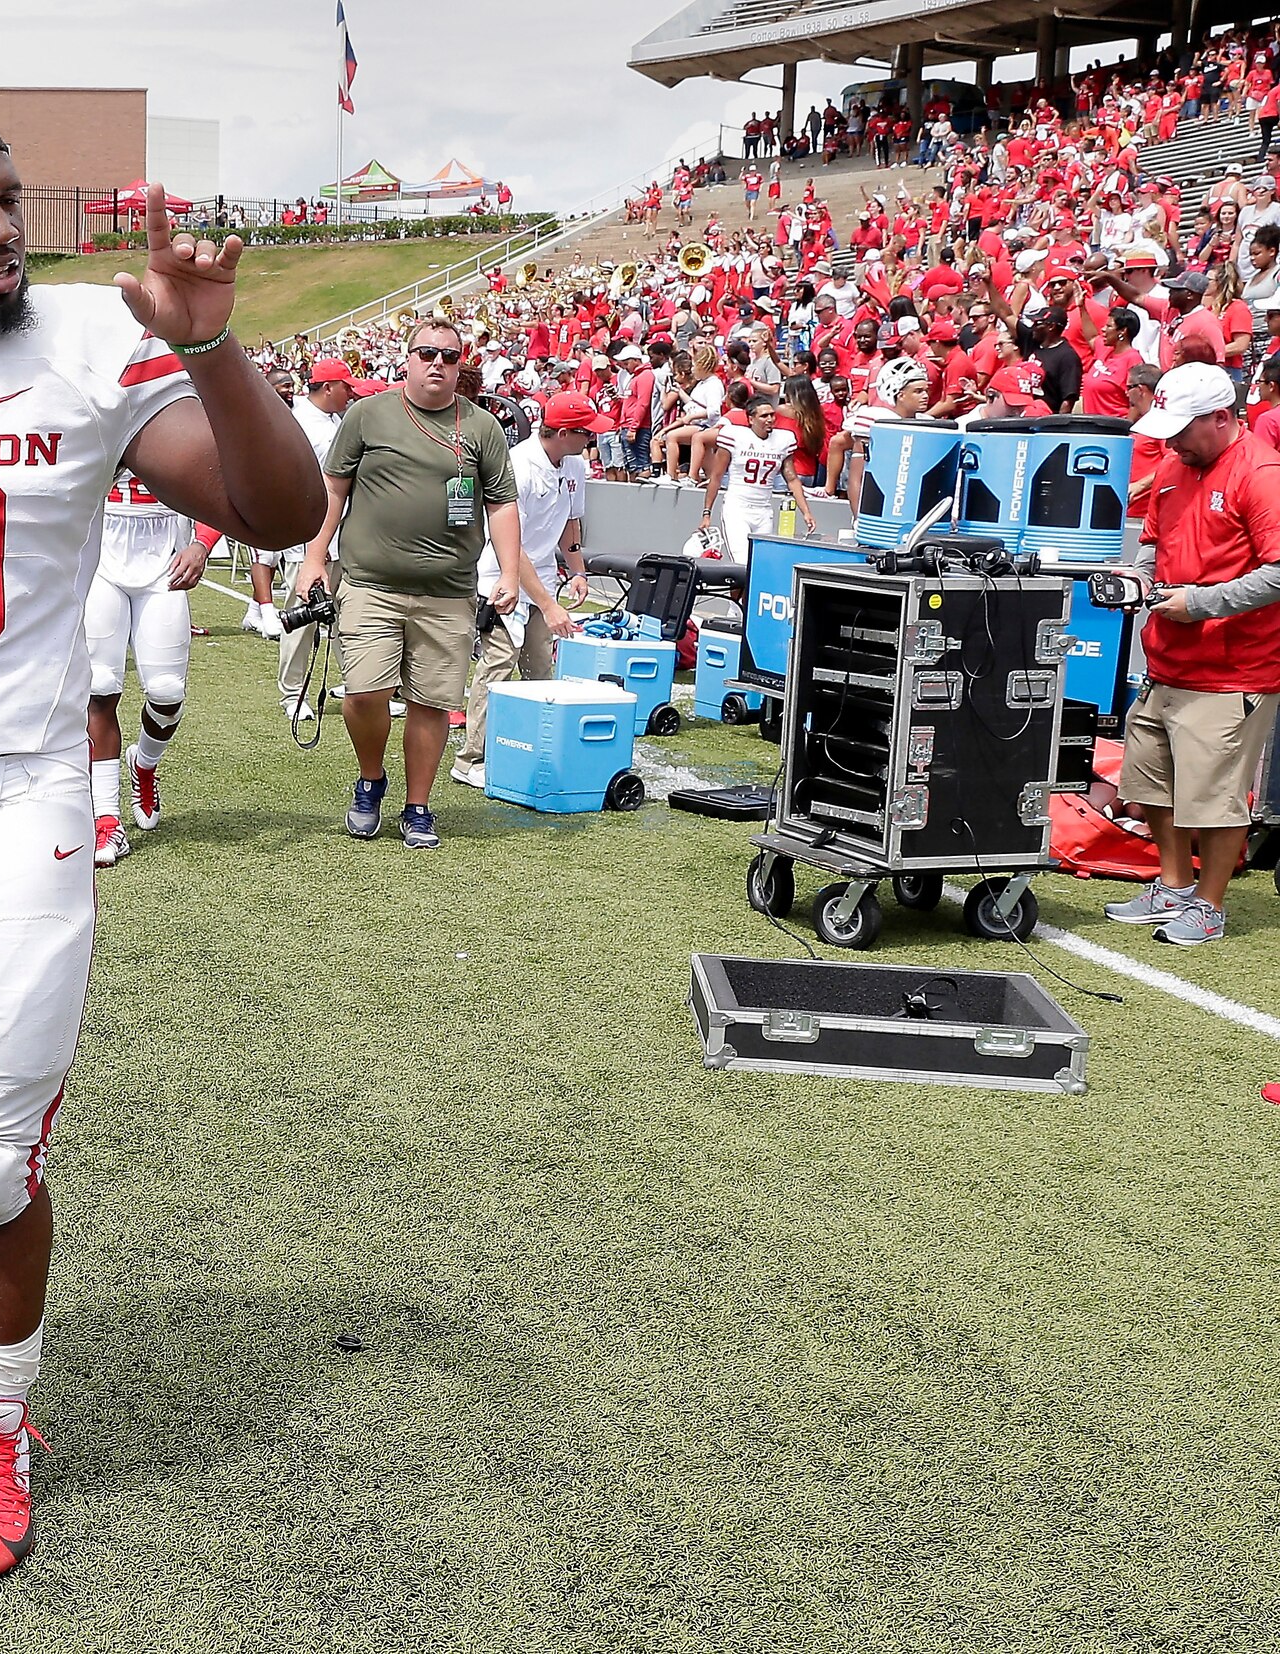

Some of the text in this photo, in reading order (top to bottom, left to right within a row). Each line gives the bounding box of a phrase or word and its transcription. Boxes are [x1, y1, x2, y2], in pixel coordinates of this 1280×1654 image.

[750, 29, 777, 43] Cotton
[780, 25, 798, 38] Bowl
[739, 450, 782, 460] HOUSTON
[743, 458, 777, 485] 97
